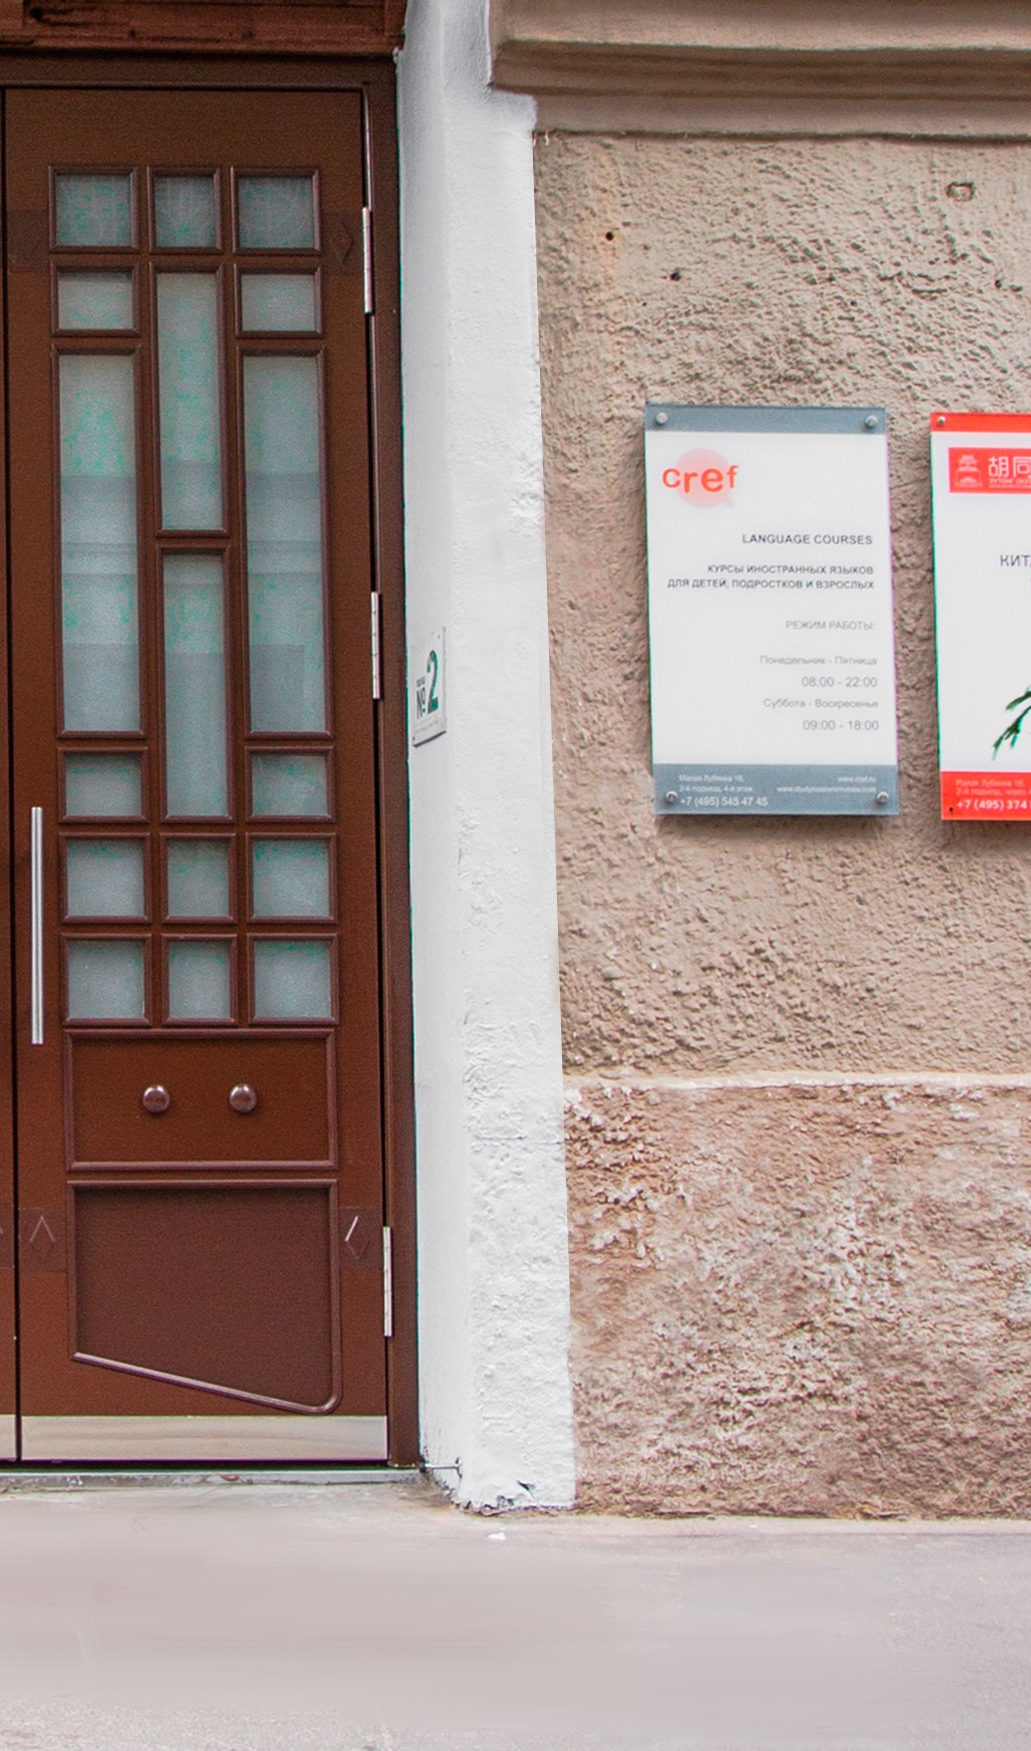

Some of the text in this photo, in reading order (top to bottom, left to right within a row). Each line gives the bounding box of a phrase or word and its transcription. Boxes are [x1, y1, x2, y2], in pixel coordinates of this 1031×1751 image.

[662, 465, 739, 493] cref
[742, 534, 873, 545] LANGUAGE COURSES
[1000, 554, 1031, 567] КИТ
[707, 564, 874, 575] КУРСЫ ИНОСТРАННЫХ ЯЗЫКОВ
[668, 578, 874, 590] ДЛЯ ДЕТЕЙ, ПОДРОСТКОВ И ВЗРОСЛЫХ
[786, 620, 826, 630] РЕЖИМ
[760, 655, 826, 665] Понедельник
[835, 656, 877, 666] Пятница
[427, 649, 438, 714] 2
[801, 676, 834, 688] 08:00
[845, 676, 878, 688] 22:00
[763, 698, 806, 709] Суббота
[815, 698, 879, 709] Воскресенье
[802, 720, 836, 731] 09:00
[848, 720, 879, 731] 18:00
[680, 796, 769, 808] +7 (495) 545 47 45
[957, 798, 1028, 812] +7 (495) 374
